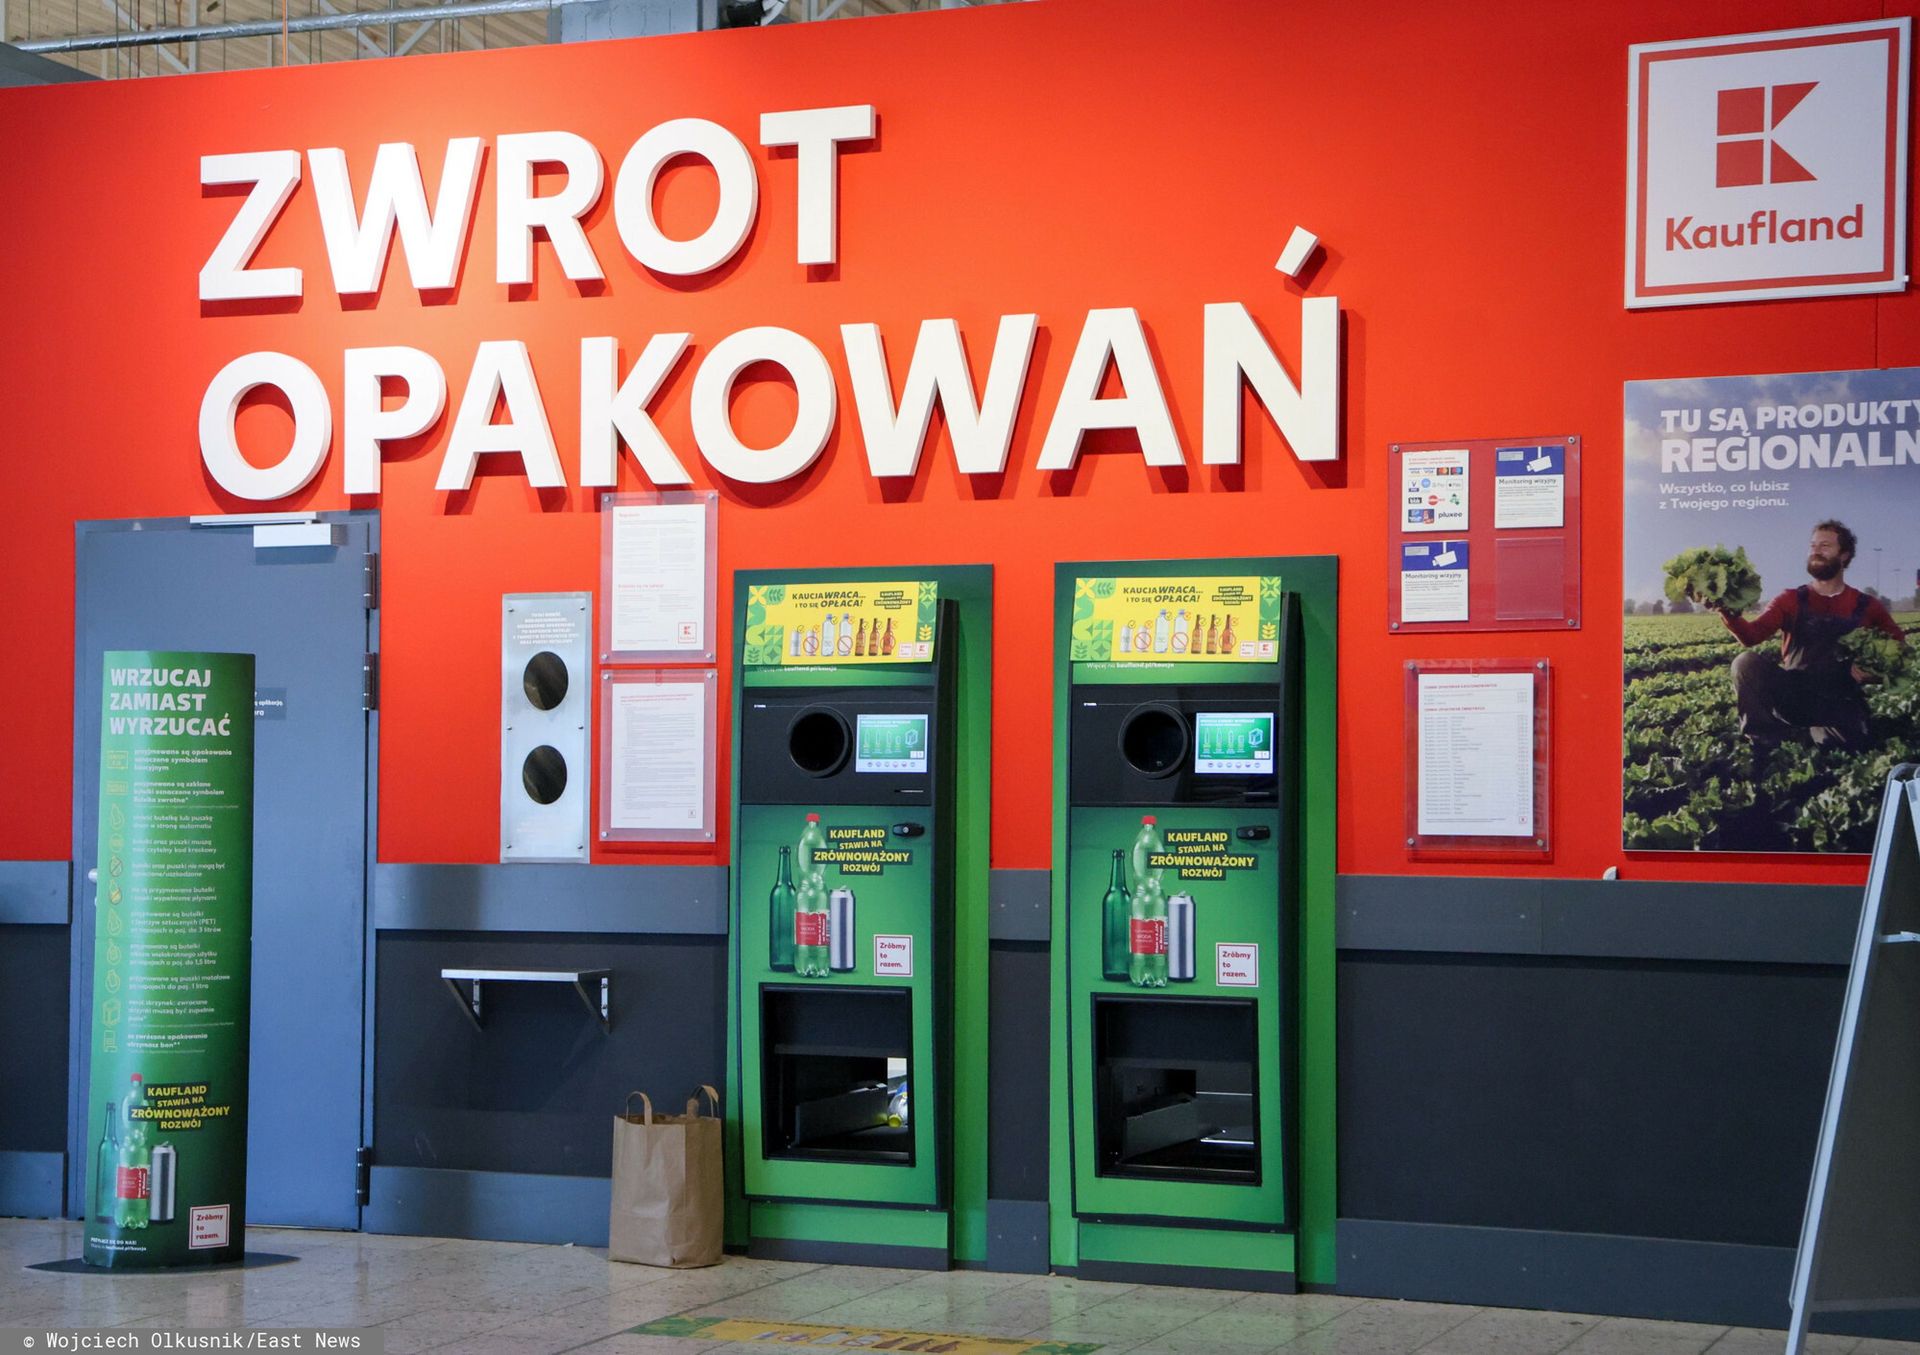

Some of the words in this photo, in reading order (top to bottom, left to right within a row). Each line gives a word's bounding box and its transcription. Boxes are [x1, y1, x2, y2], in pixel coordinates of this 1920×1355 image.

[198, 104, 876, 300] ZWROT
[1665, 204, 1863, 251] Kaufland
[198, 225, 1340, 500] OPAKOWAŃ
[1660, 409, 1701, 433] TU
[1709, 407, 1752, 437] SĄ
[1661, 430, 1920, 474] REGIONALN
[1498, 478, 1533, 486] Monitoring
[1659, 482, 1727, 495] Wszystko,
[1730, 483, 1745, 493] co
[1750, 481, 1789, 492] lubisz
[1659, 502, 1667, 510] z
[1670, 497, 1728, 511] Twojego
[1732, 497, 1789, 511] regionu.
[1438, 511, 1463, 519] pluxee
[792, 592, 824, 600] KAUCJA
[1154, 595, 1200, 603] OPŁACA!
[820, 600, 863, 608] OPŁACA!
[110, 668, 211, 688] WRZUCAJ
[110, 692, 207, 712] ZAMIAST
[109, 712, 231, 736] WYRZUCAĆ
[191, 748, 233, 756] opakowania
[830, 829, 885, 839] KAUFLAND
[1167, 832, 1228, 842] KAUFLAND
[839, 841, 870, 850] STAWIA
[871, 840, 883, 848] NA
[1178, 845, 1211, 854] STAWIA
[1212, 843, 1225, 852] NA
[814, 850, 910, 862] ZRÓWNOWAŻONY
[1150, 854, 1255, 867] ZRÓWNOWAŻONY
[842, 863, 881, 873] ROZWÓJ
[1181, 867, 1223, 878] ROZWÓJ
[880, 942, 906, 951] Zróbmy
[1222, 951, 1251, 960] Zróbmy
[1222, 970, 1247, 978] razem.
[147, 1085, 207, 1096] KAUFLAND
[157, 1098, 190, 1108] STAWIA
[191, 1096, 204, 1104] NA
[131, 1106, 231, 1118] ZRÓWNOWAŻONY
[160, 1119, 202, 1129] ROZWÓJ
[196, 1213, 224, 1222] Zróbmy
